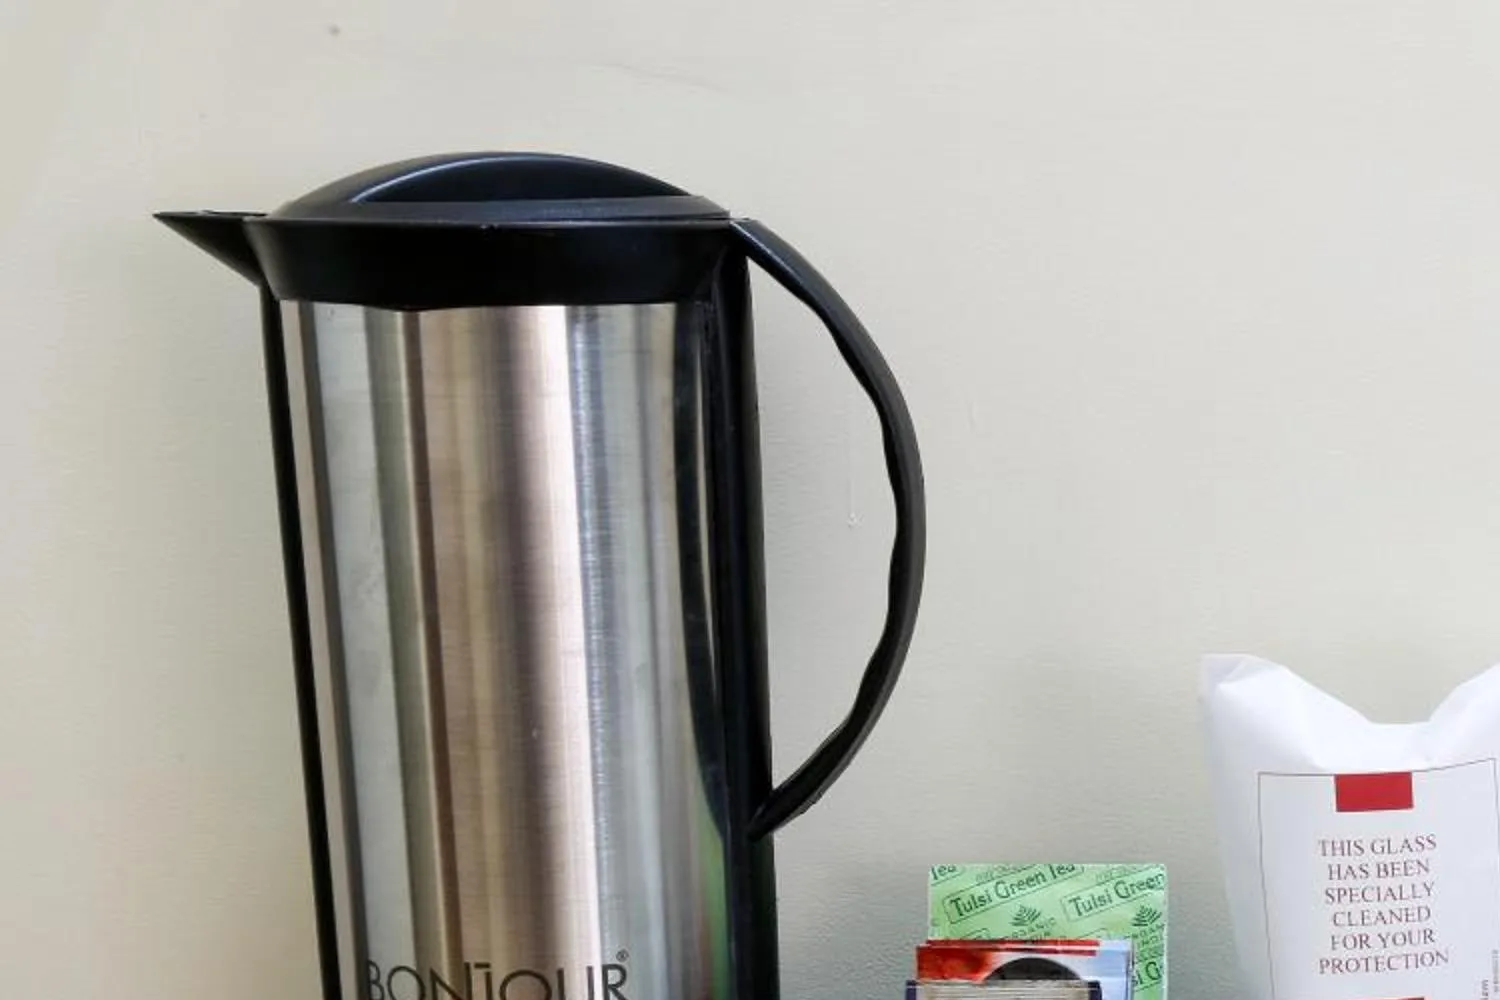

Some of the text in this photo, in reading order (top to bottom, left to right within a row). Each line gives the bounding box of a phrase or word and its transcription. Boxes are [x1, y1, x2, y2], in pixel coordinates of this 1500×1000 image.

[1318, 834, 1437, 857] THIS GLASS
[1327, 860, 1431, 881] HAS BEEN
[949, 889, 993, 917] Tulsi
[994, 870, 1047, 899] Green
[1068, 888, 1113, 917] Tulsi
[1324, 882, 1436, 905] SPECIALLY
[1333, 905, 1432, 927] CLEANED
[1331, 930, 1436, 951] FOR YOUR
[1318, 950, 1450, 975] PROTECTION
